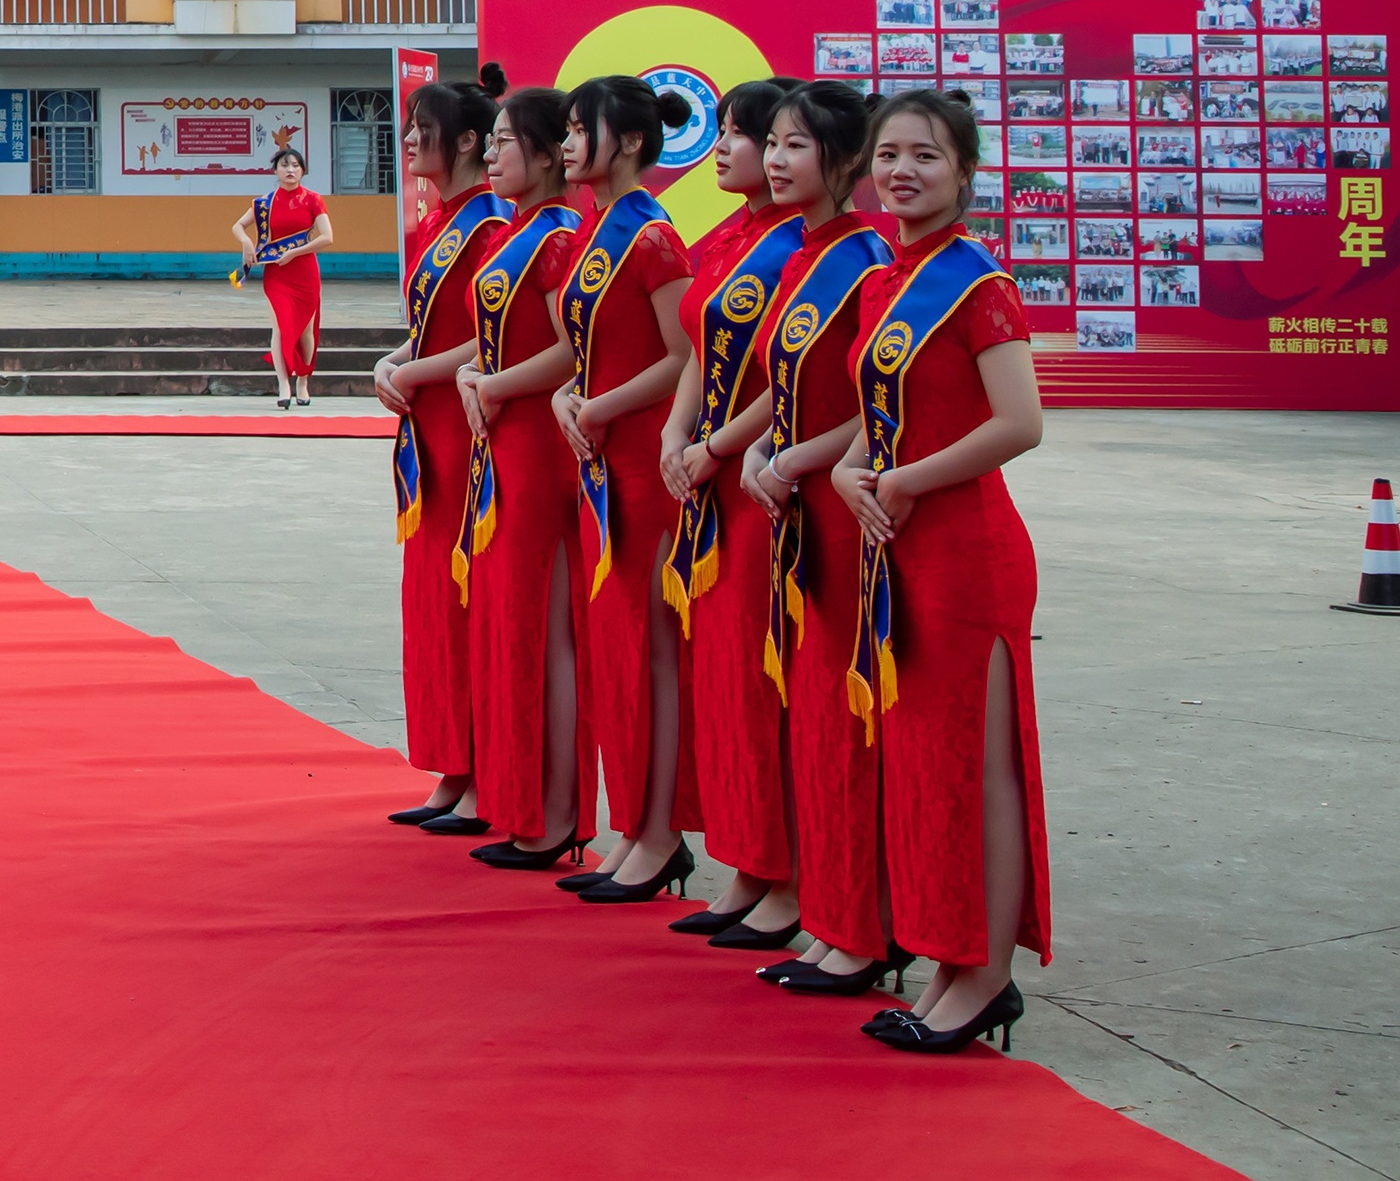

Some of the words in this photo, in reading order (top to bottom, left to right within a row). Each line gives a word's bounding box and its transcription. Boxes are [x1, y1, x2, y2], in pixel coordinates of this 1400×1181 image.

[11, 92, 24, 160] 梅港派出所治安
[1338, 177, 1387, 268] 周年
[1268, 316, 1388, 335] 薪火相传二十载
[1268, 337, 1388, 355] 砥砺前行正青春
